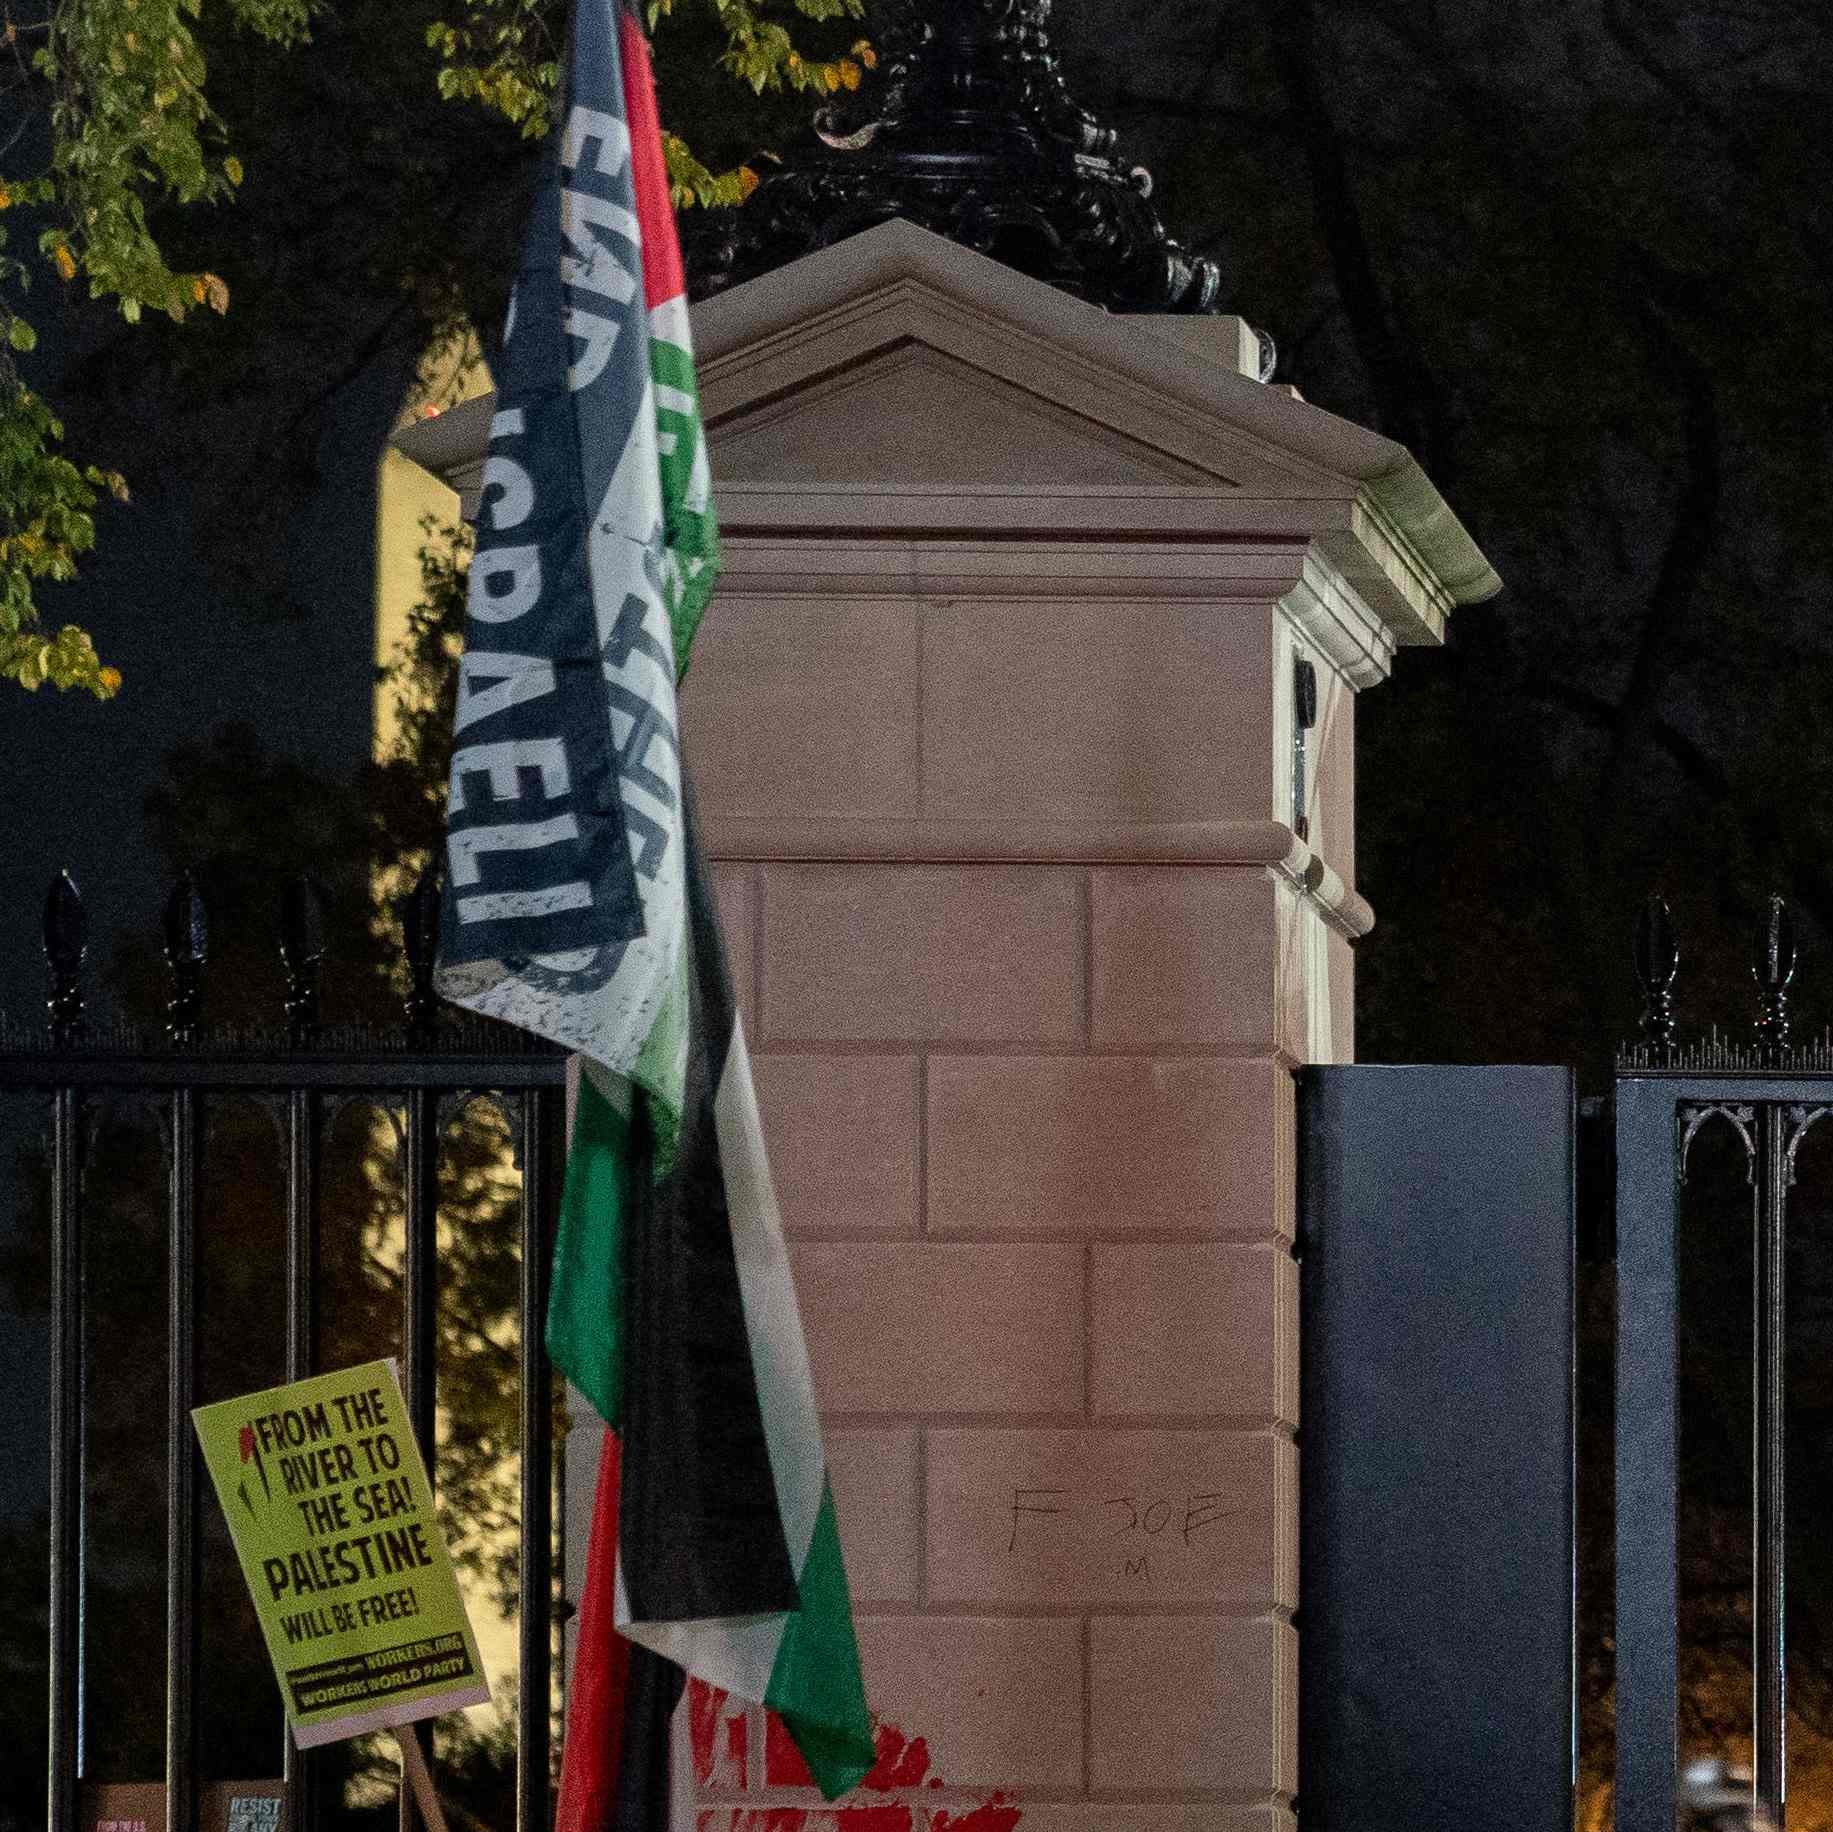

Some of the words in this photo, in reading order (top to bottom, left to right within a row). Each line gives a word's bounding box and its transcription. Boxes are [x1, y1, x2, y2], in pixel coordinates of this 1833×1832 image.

[256, 1403, 332, 1453] FROM
[332, 1389, 388, 1433] THE
[280, 1444, 358, 1495] RIVER
[358, 1433, 400, 1474] TO
[298, 1493, 350, 1536] THE
[354, 1477, 417, 1523] SEA!
[263, 1524, 432, 1601] PALESTINE
[280, 1609, 333, 1644] WILL
[332, 1603, 356, 1632] BE
[358, 1587, 420, 1627] FREE!
[301, 1680, 368, 1706] WORKERS
[367, 1668, 423, 1691] WORLD
[423, 1656, 465, 1679] PARTY
[231, 1798, 281, 1814] RESIST
